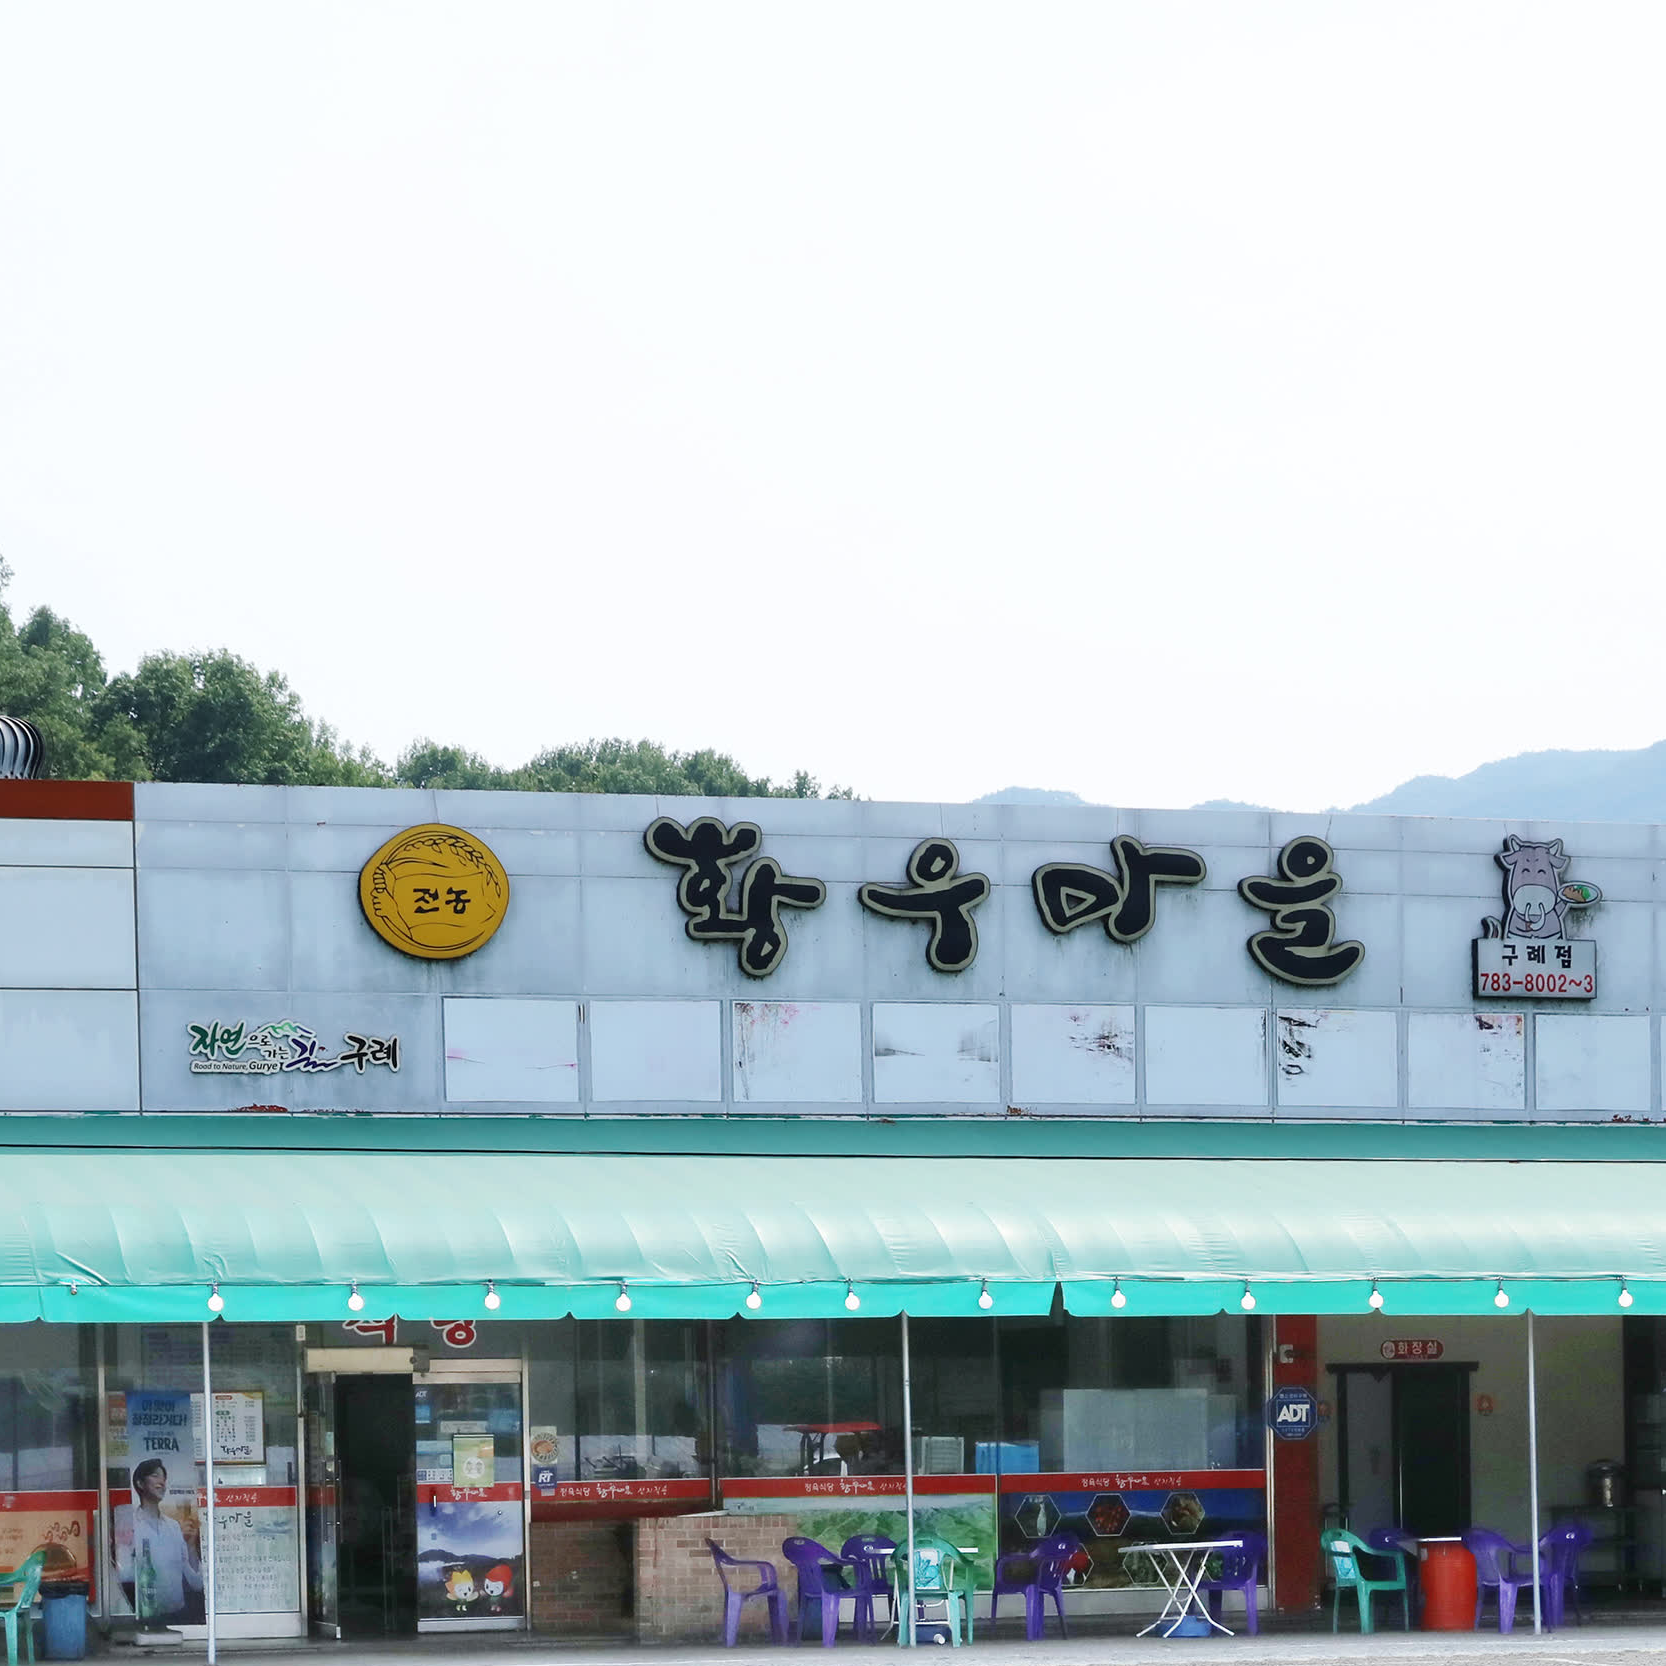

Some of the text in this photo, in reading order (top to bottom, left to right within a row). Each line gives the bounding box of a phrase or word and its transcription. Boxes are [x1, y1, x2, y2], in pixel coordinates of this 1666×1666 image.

[412, 887, 471, 914] 전농
[644, 815, 1366, 985] 황우마을
[1502, 944, 1572, 968] 구례점
[1480, 973, 1593, 993] 783-8002~3
[340, 1035, 398, 1071] 구례
[194, 1062, 213, 1070] Road
[213, 1062, 221, 1070] to
[249, 1061, 278, 1072] Gurye
[1397, 1341, 1438, 1355] 화장실
[1277, 1404, 1310, 1422] ADT
[143, 1437, 180, 1452] TERRA
